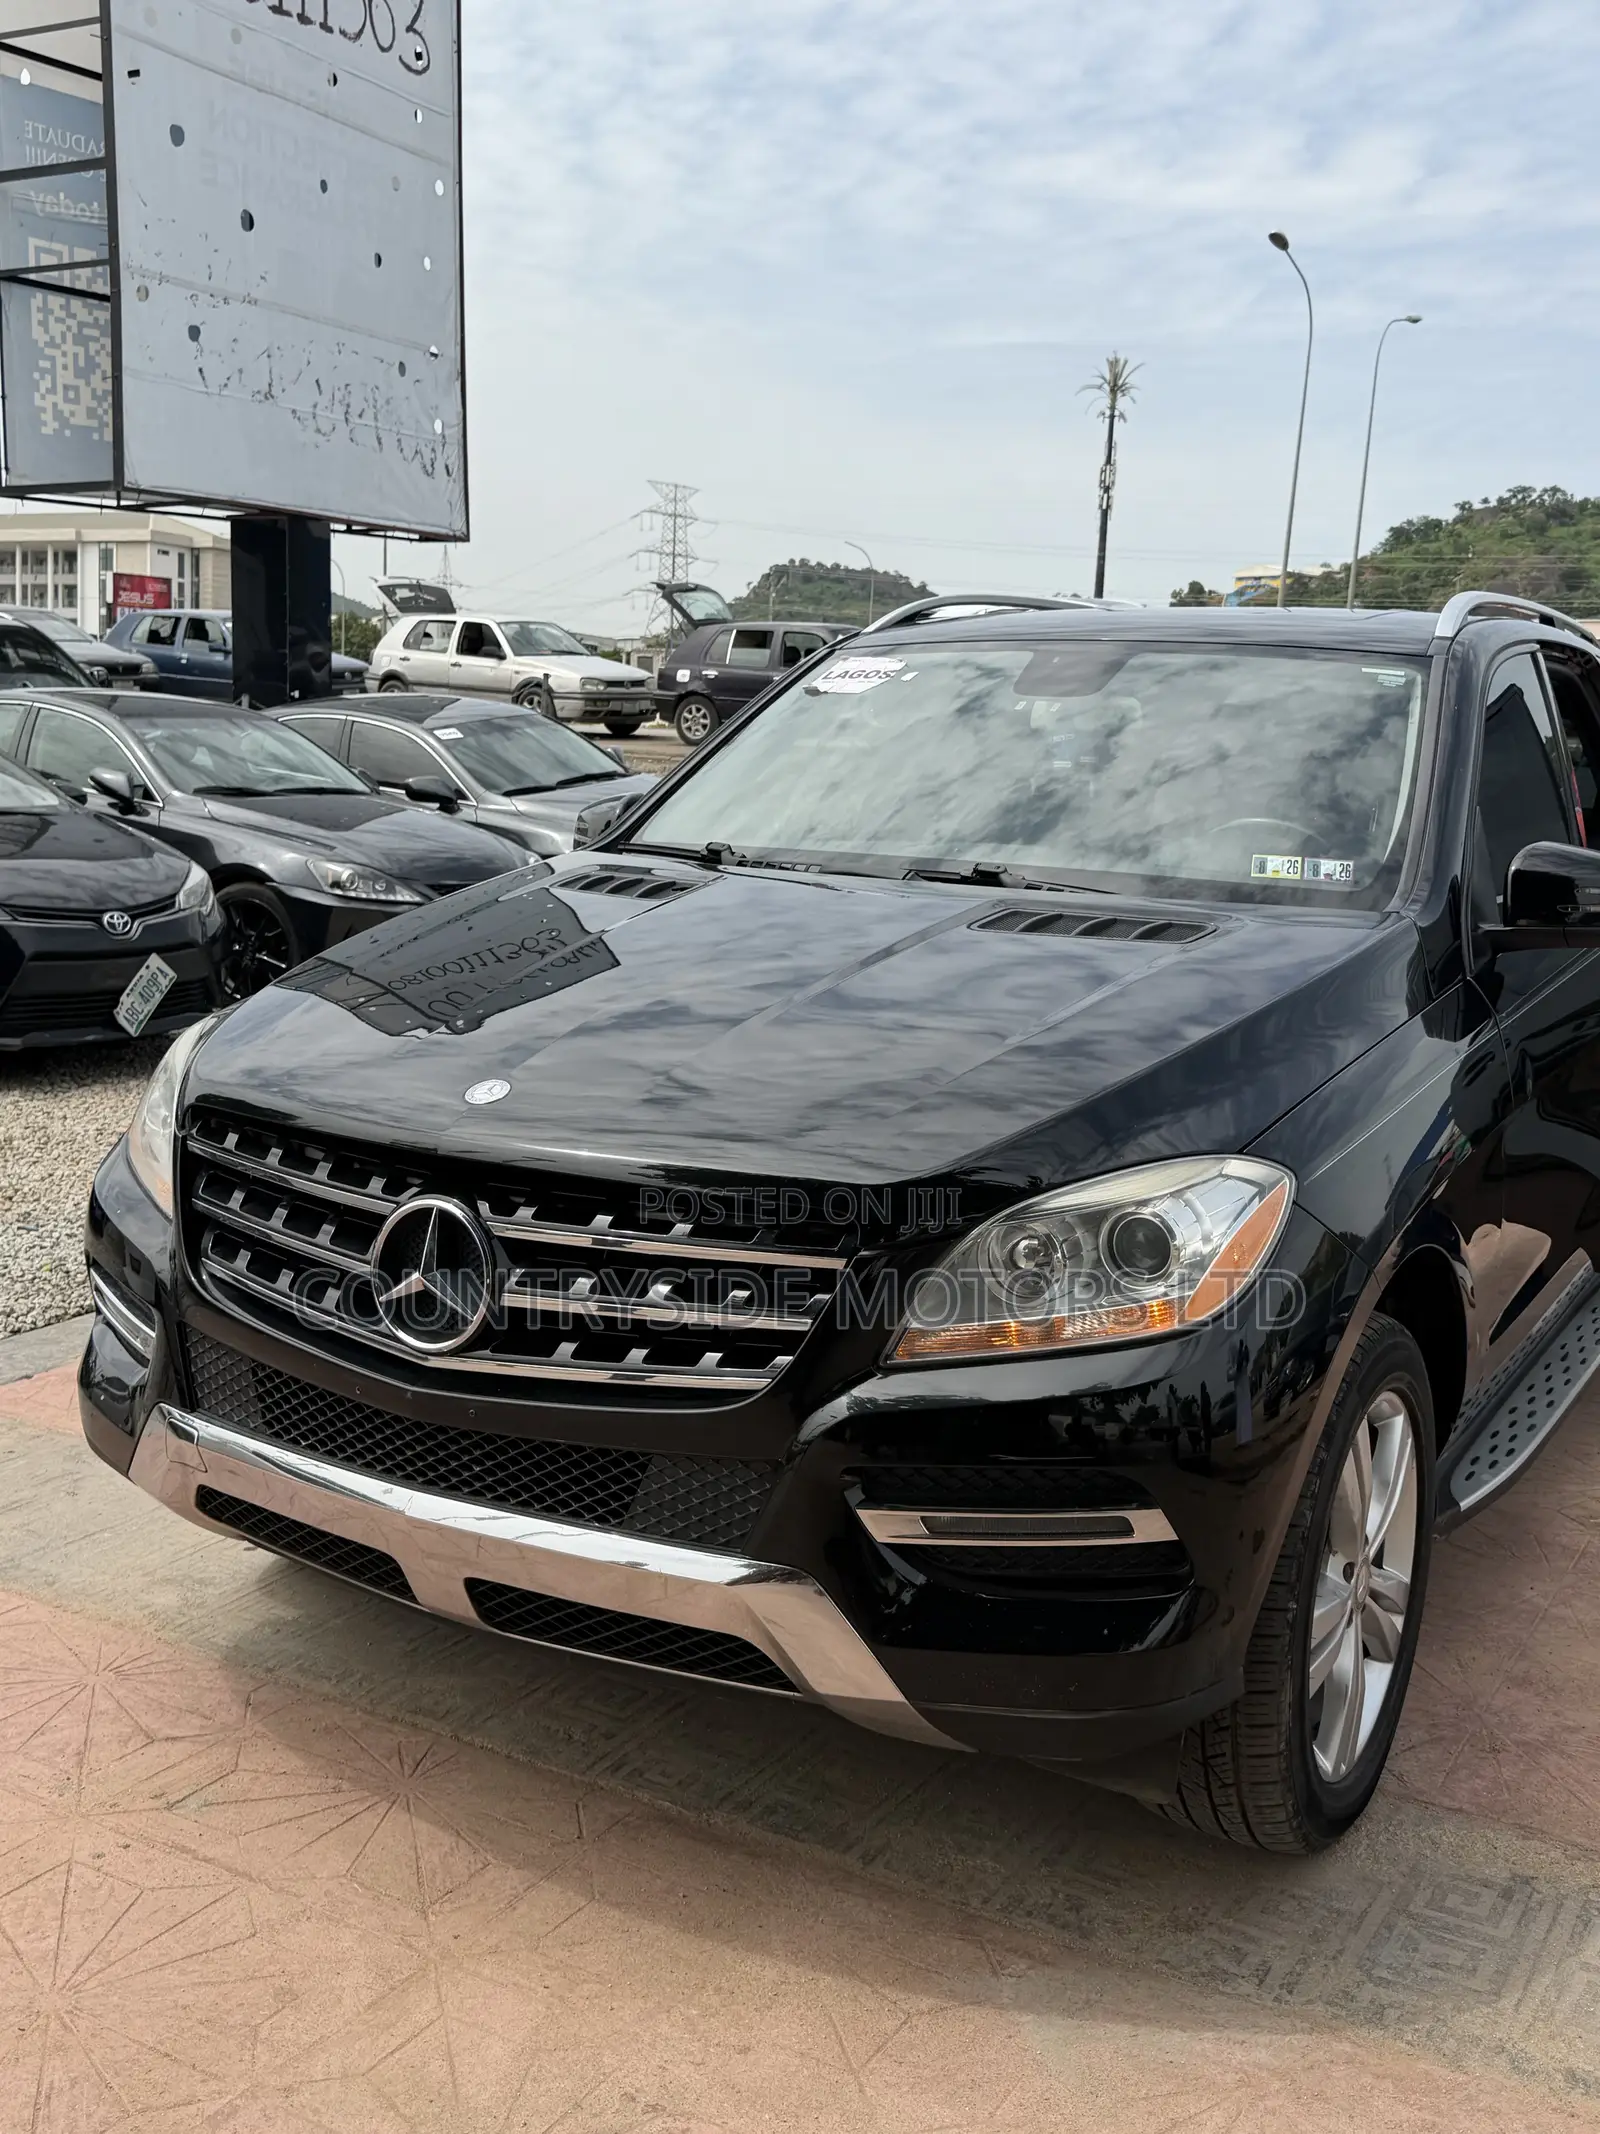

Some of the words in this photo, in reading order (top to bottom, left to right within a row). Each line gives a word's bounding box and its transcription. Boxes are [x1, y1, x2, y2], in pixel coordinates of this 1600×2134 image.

[821, 669, 894, 680] LAGOS
[1286, 859, 1299, 875] 26
[1339, 862, 1351, 879] 26
